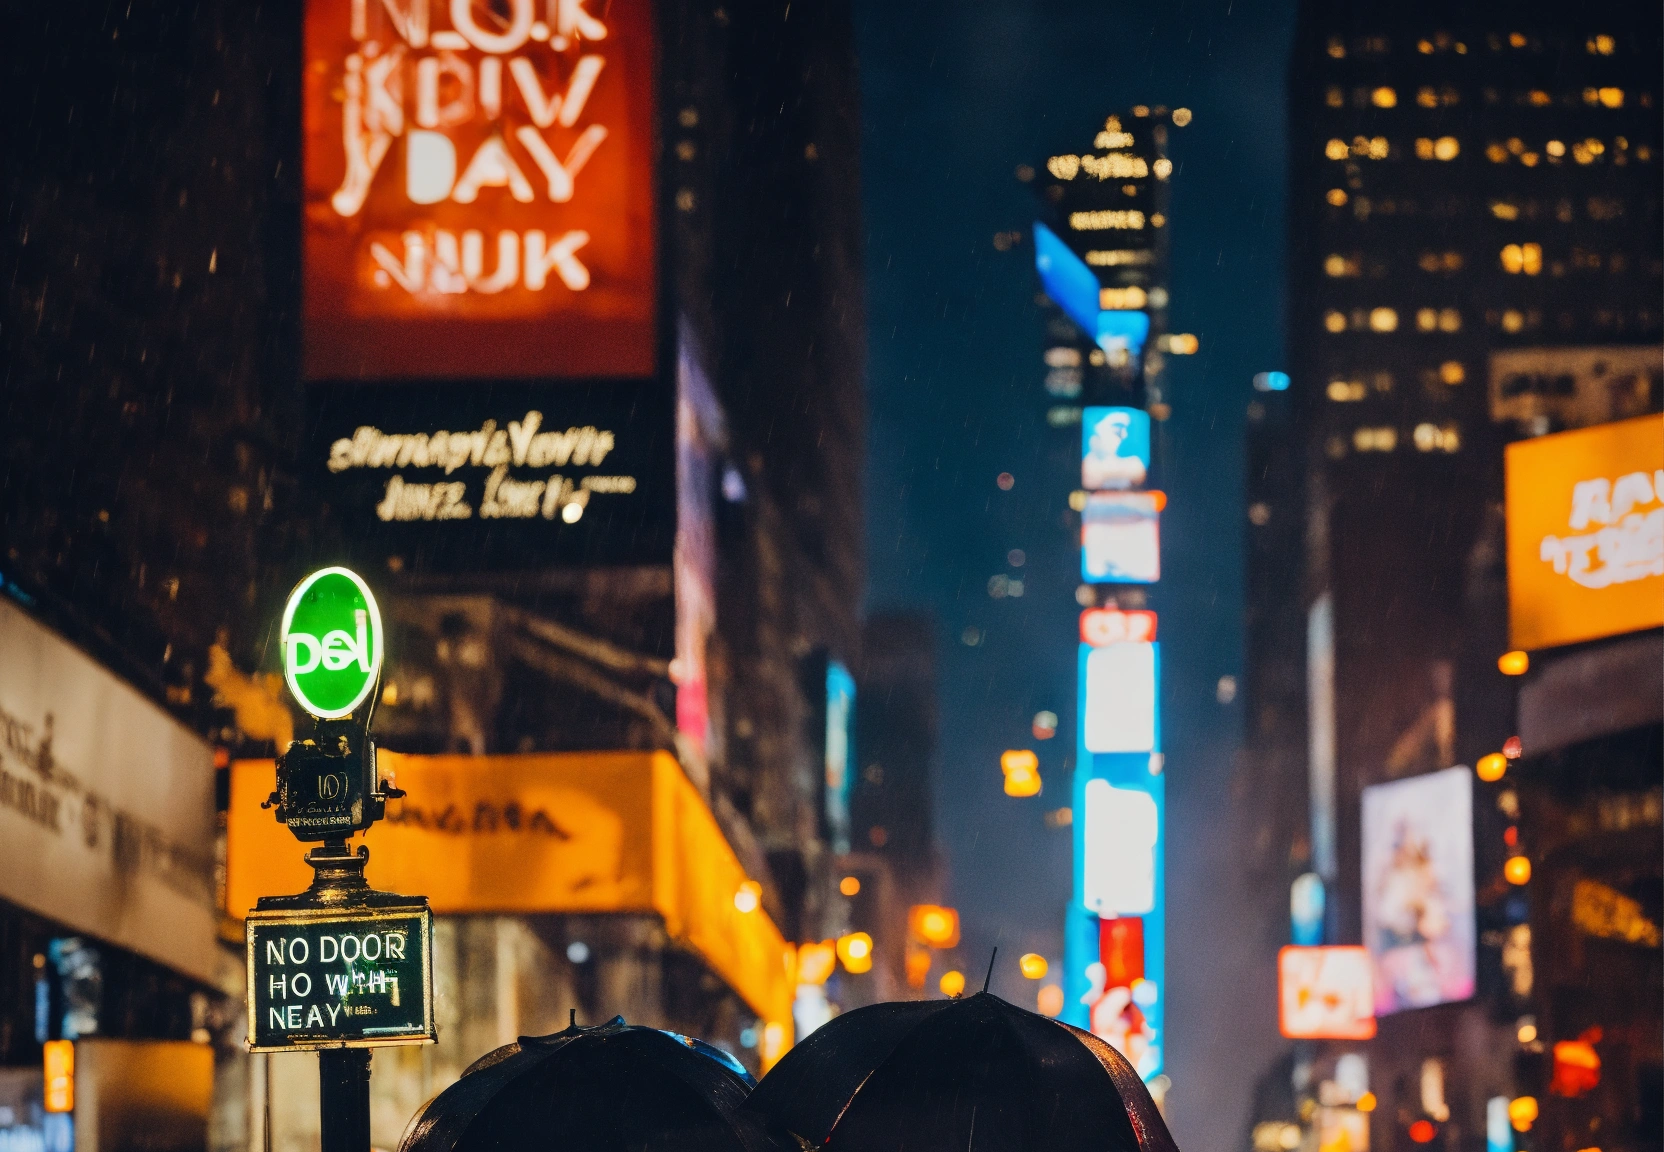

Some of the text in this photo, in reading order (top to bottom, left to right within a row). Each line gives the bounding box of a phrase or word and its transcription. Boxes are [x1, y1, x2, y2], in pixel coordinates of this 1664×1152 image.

[266, 933, 407, 965] NO DOOR
[269, 972, 312, 1000] HO
